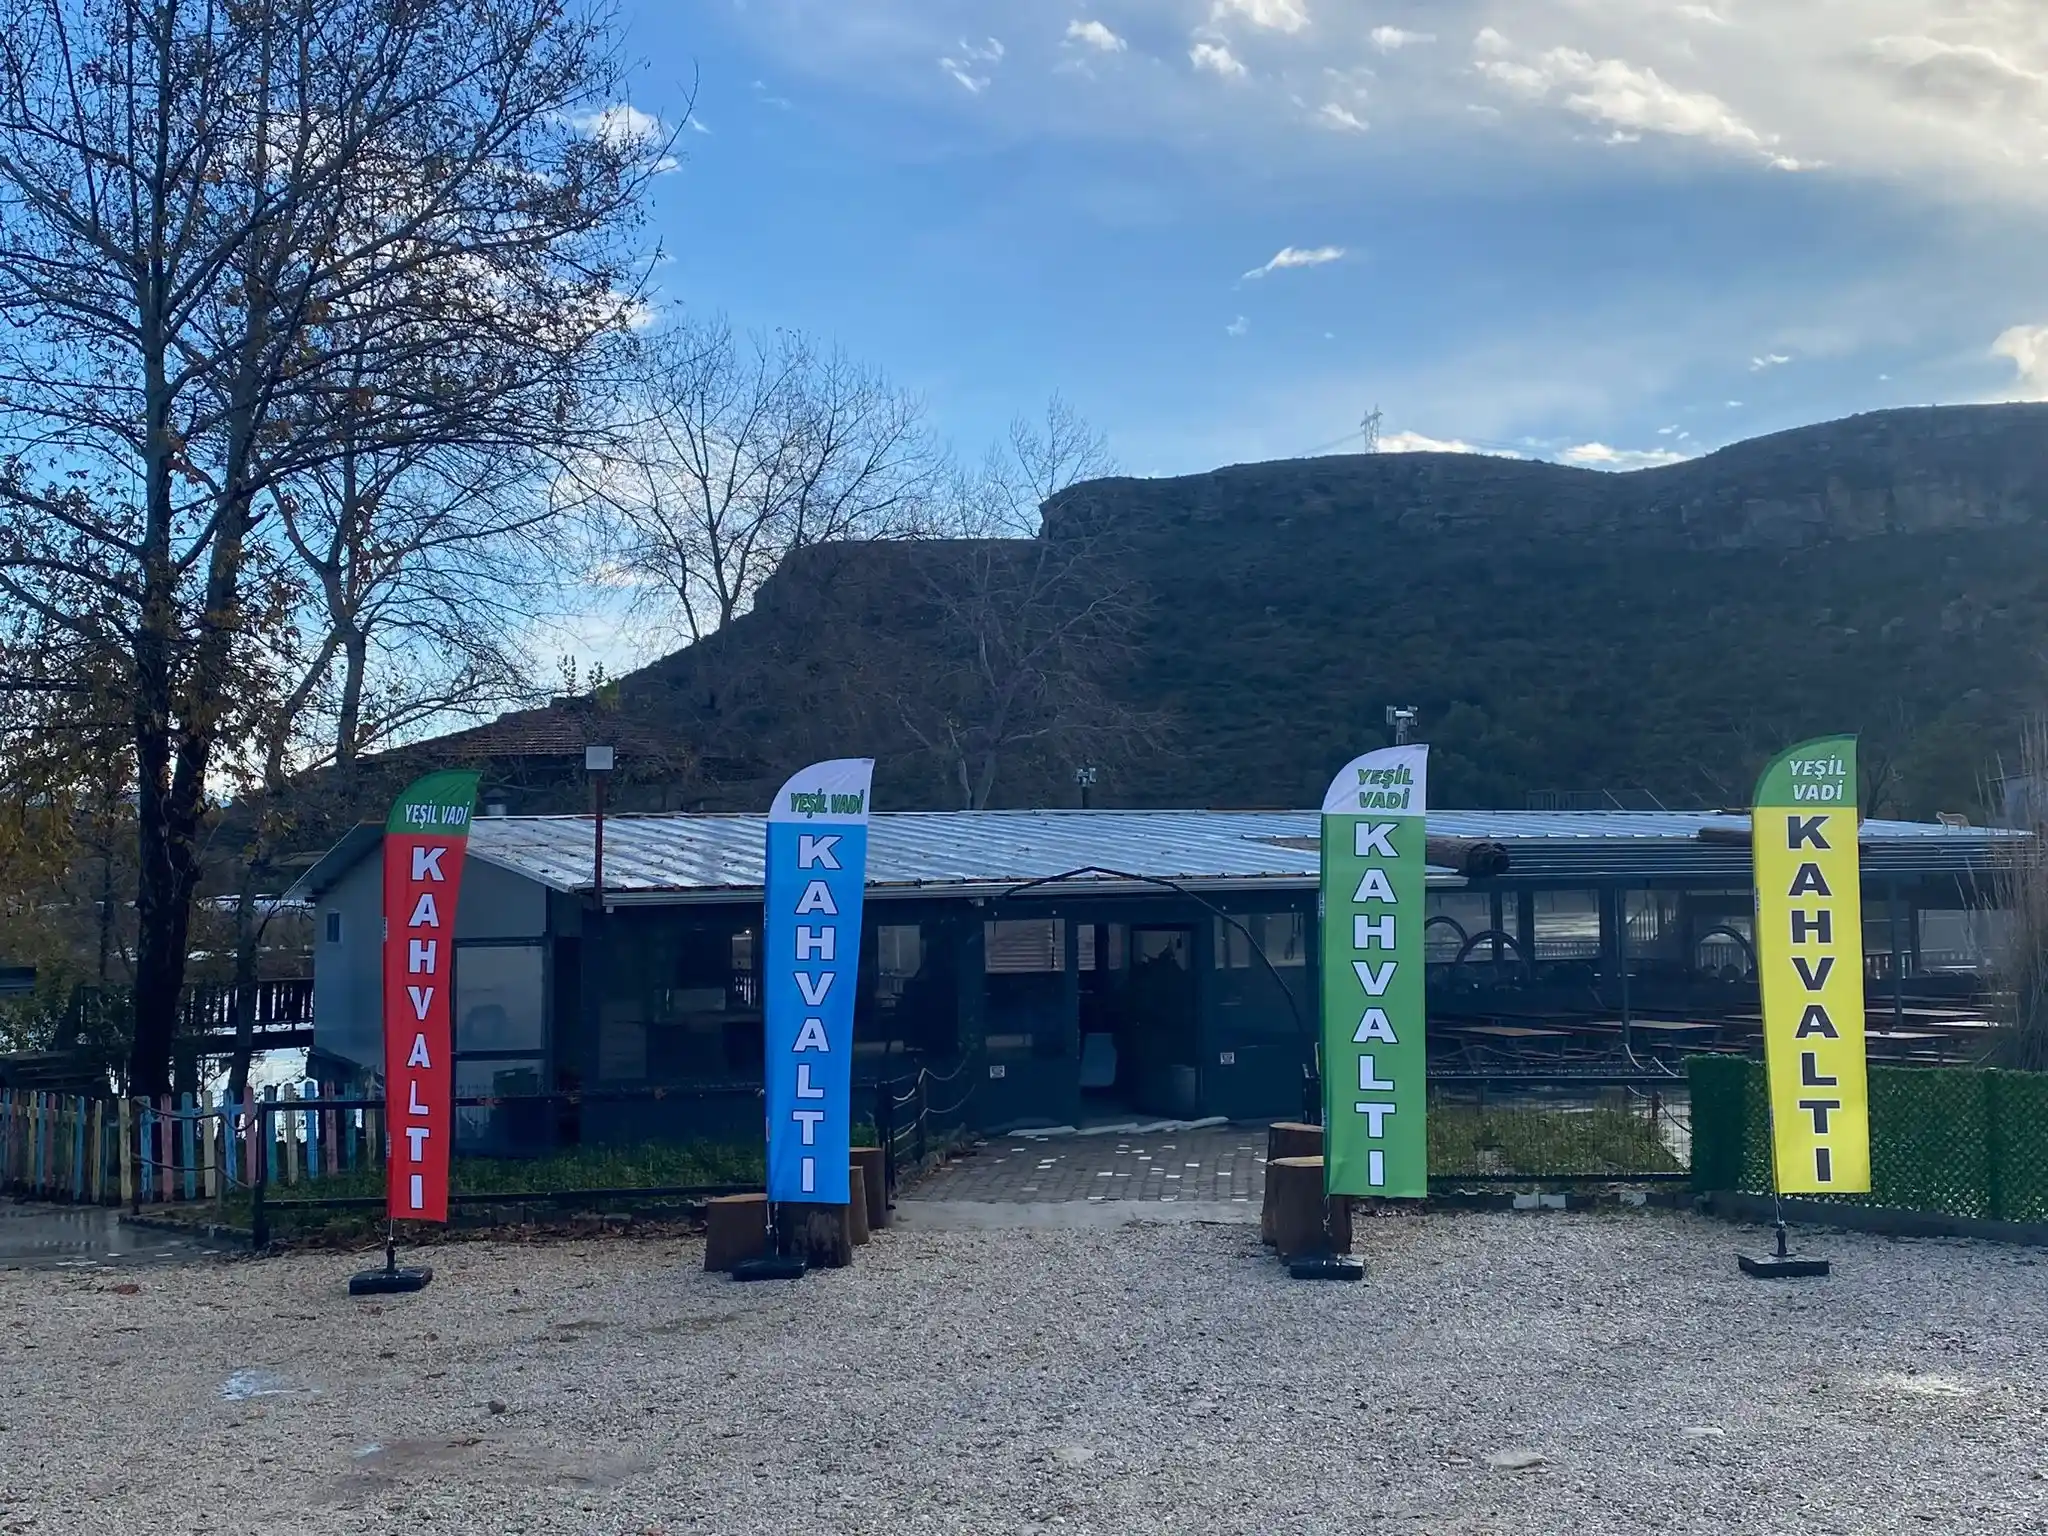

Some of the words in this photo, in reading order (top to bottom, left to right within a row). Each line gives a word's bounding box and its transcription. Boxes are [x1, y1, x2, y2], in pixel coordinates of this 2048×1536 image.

[1357, 764, 1414, 789] YEŞİL
[1788, 754, 1846, 780] YEŞİL
[790, 788, 828, 819] YEŞİL
[831, 789, 865, 814] VADİ
[1359, 788, 1410, 809] VADİ
[1793, 779, 1843, 801] VADİ
[405, 799, 438, 829] YEŞİL
[441, 801, 470, 825] VADİ
[791, 834, 843, 1193] KAHVALTI
[1351, 821, 1400, 1187] KAHVALTI
[1786, 814, 1841, 1183] KAHVALTI
[405, 845, 447, 1210] KAHVALTI
